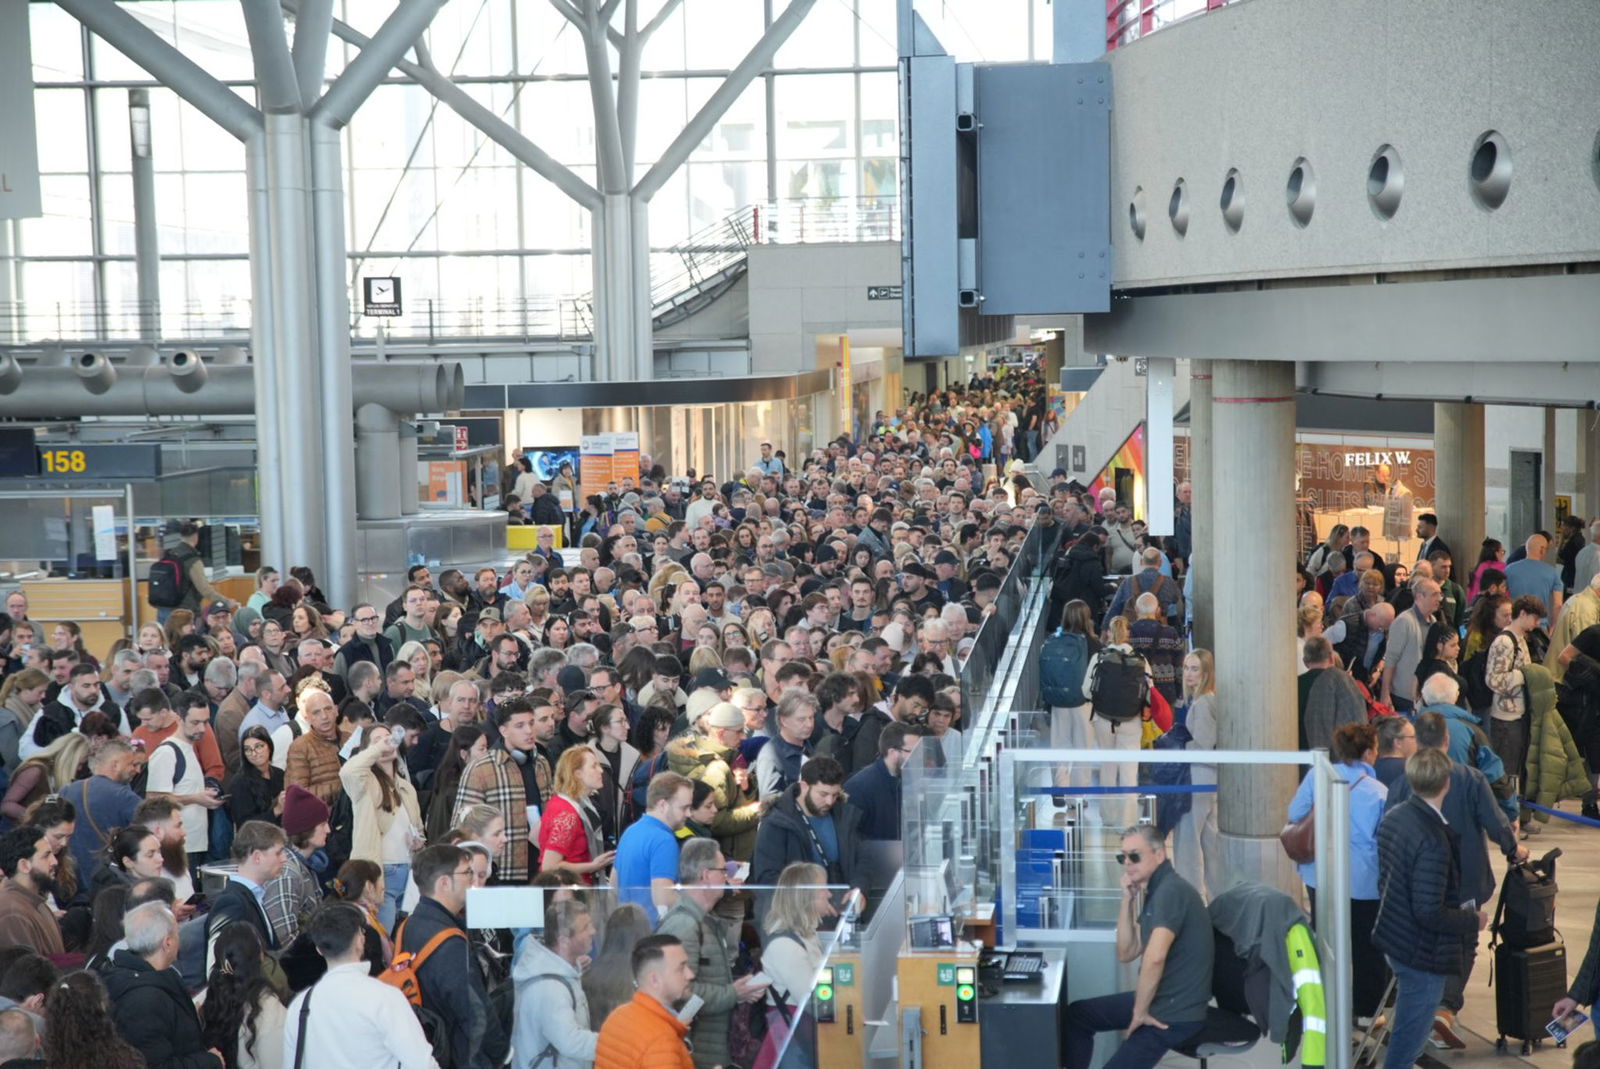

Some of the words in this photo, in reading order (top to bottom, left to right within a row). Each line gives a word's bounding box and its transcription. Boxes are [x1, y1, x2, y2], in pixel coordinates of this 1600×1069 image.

[43, 451, 86, 472] 158
[1345, 453, 1392, 466] FELIX
[1394, 451, 1411, 464] W.
